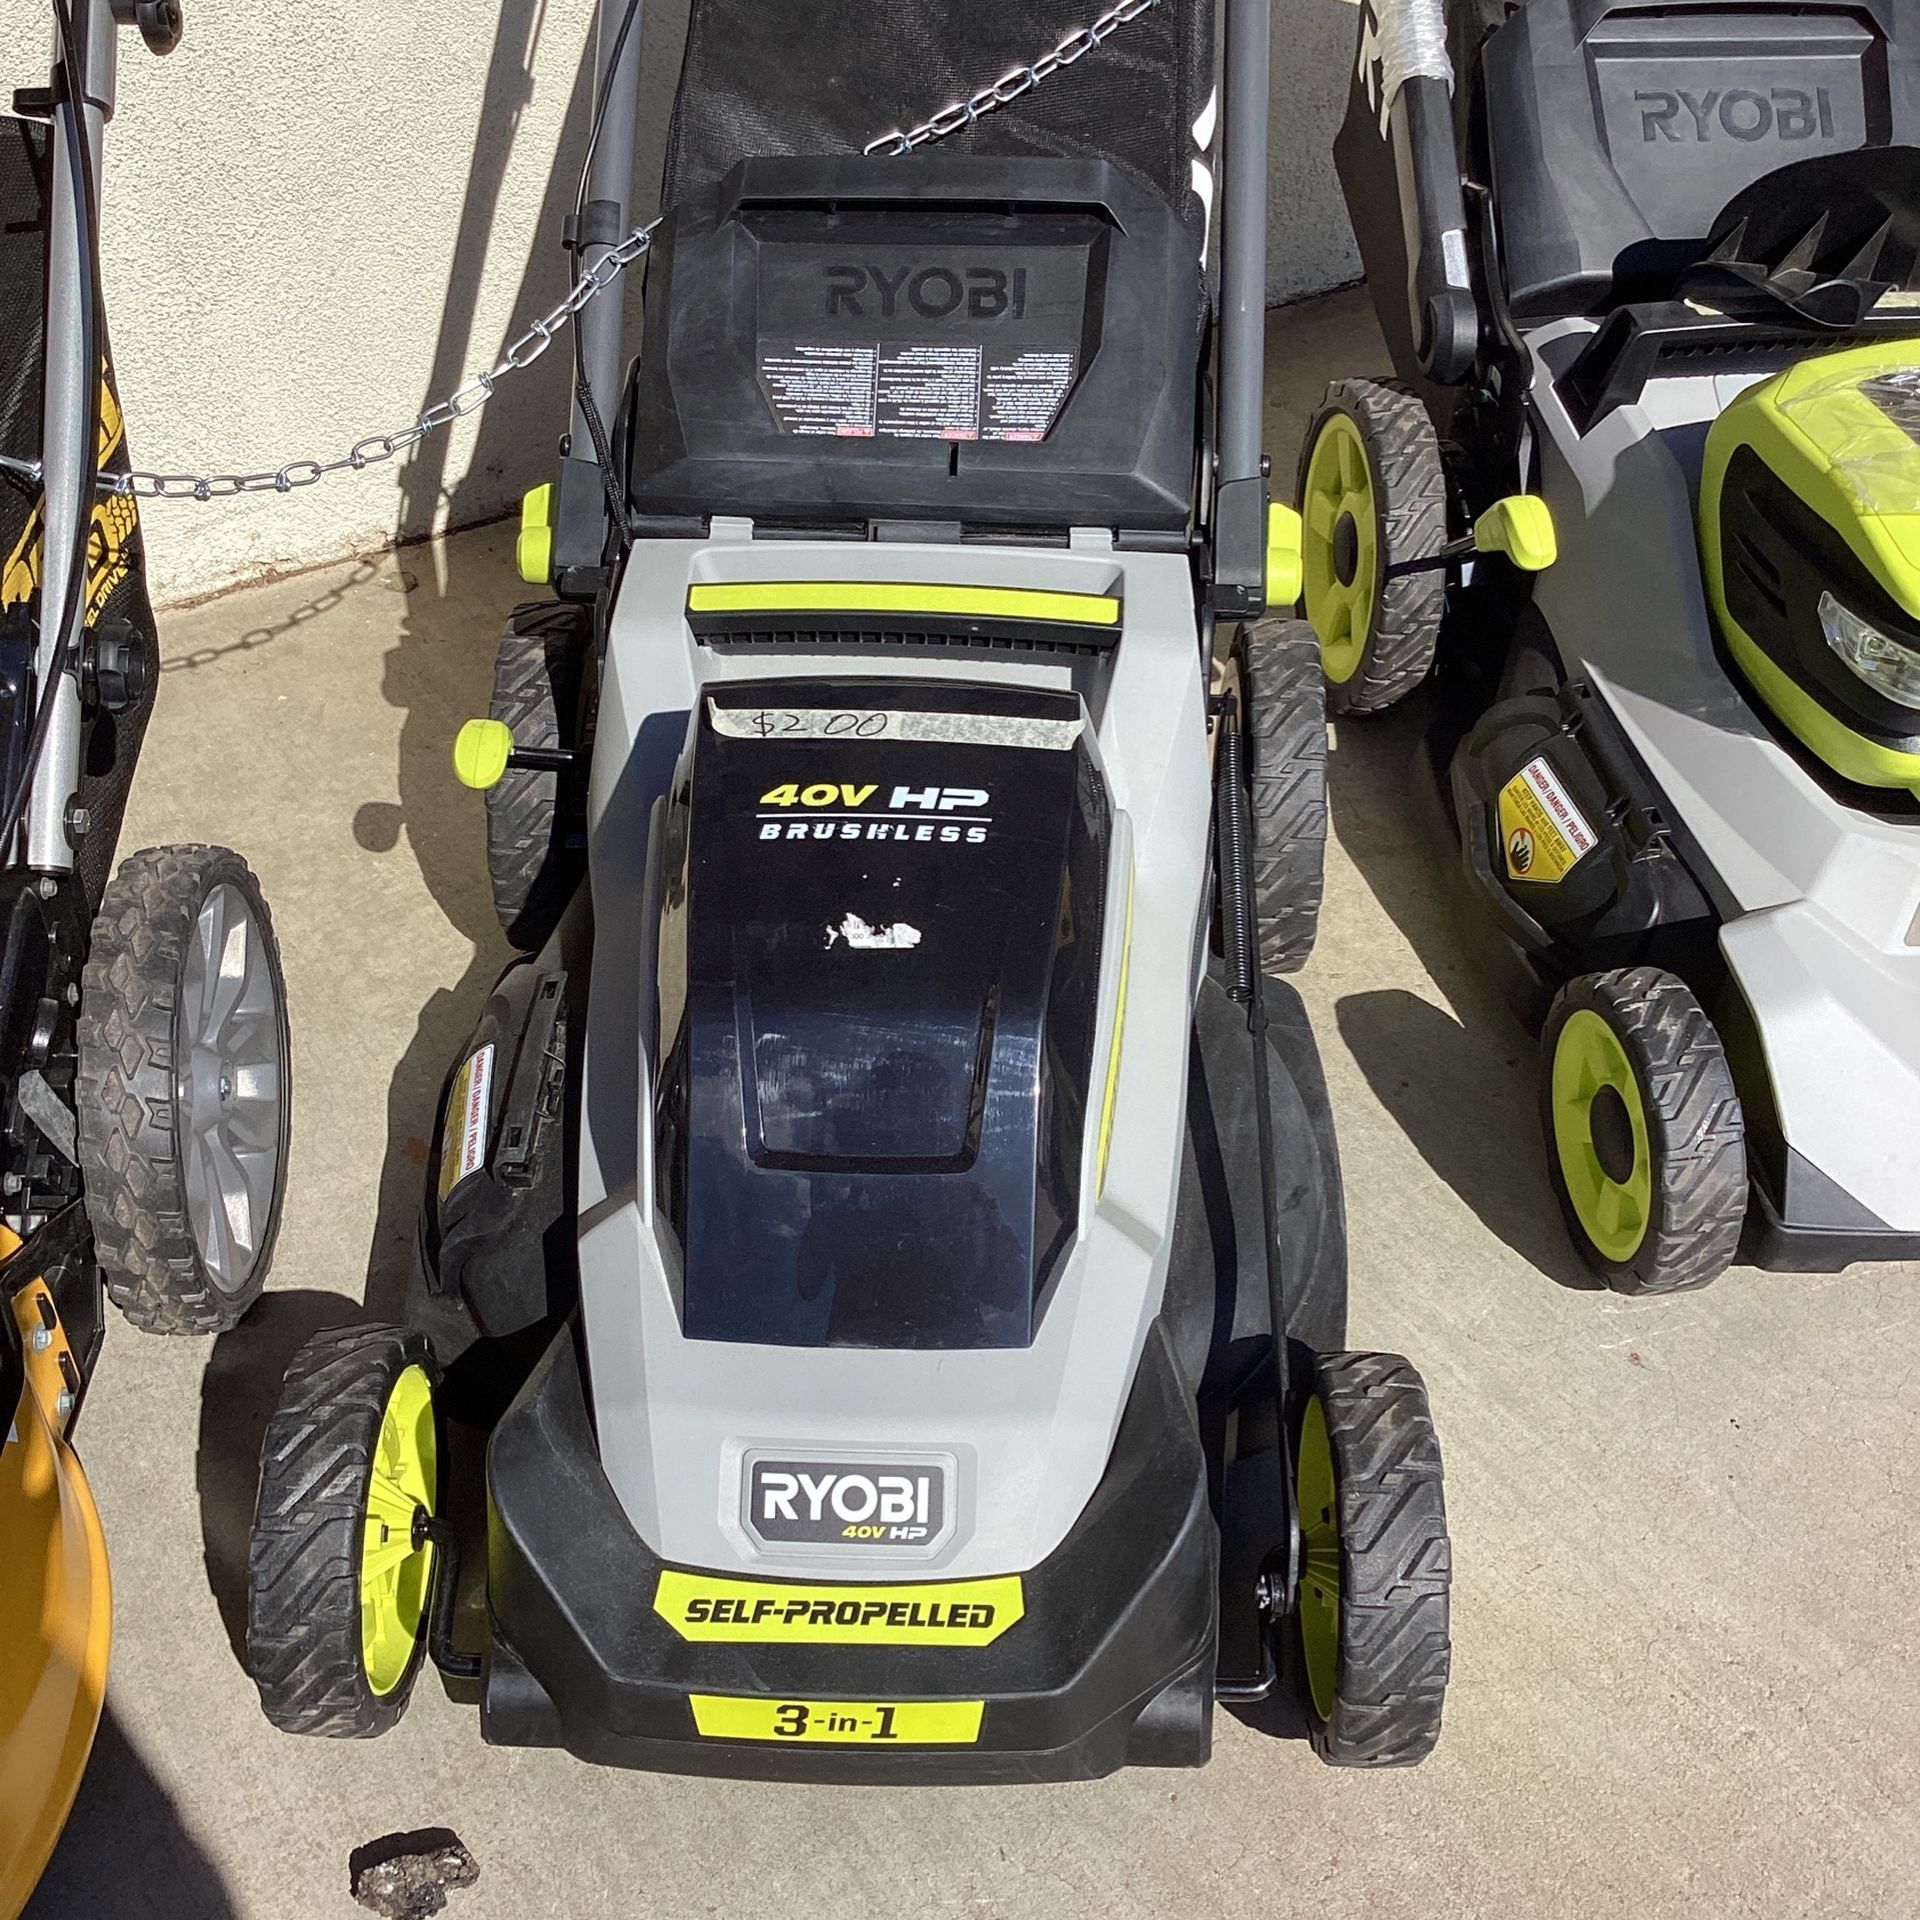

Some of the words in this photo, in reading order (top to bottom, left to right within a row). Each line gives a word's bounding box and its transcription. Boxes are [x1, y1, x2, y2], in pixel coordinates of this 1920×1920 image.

[1634, 87, 1834, 142] RYOBI
[822, 265, 1027, 320] RYOBI
[758, 784, 879, 807] 40V
[888, 785, 990, 810] HP
[1528, 764, 1550, 791] DANGER
[1545, 792, 1569, 820] DANGER
[1565, 821, 1590, 851] PELIGRO
[758, 823, 988, 844] BRUSHLESS
[760, 1472, 929, 1523] RYOBI
[842, 1525, 886, 1539] 40V
[889, 1526, 928, 1539] HP
[684, 1599, 996, 1628] SELF-PROPELLED
[773, 1704, 898, 1739] 3-in-1
